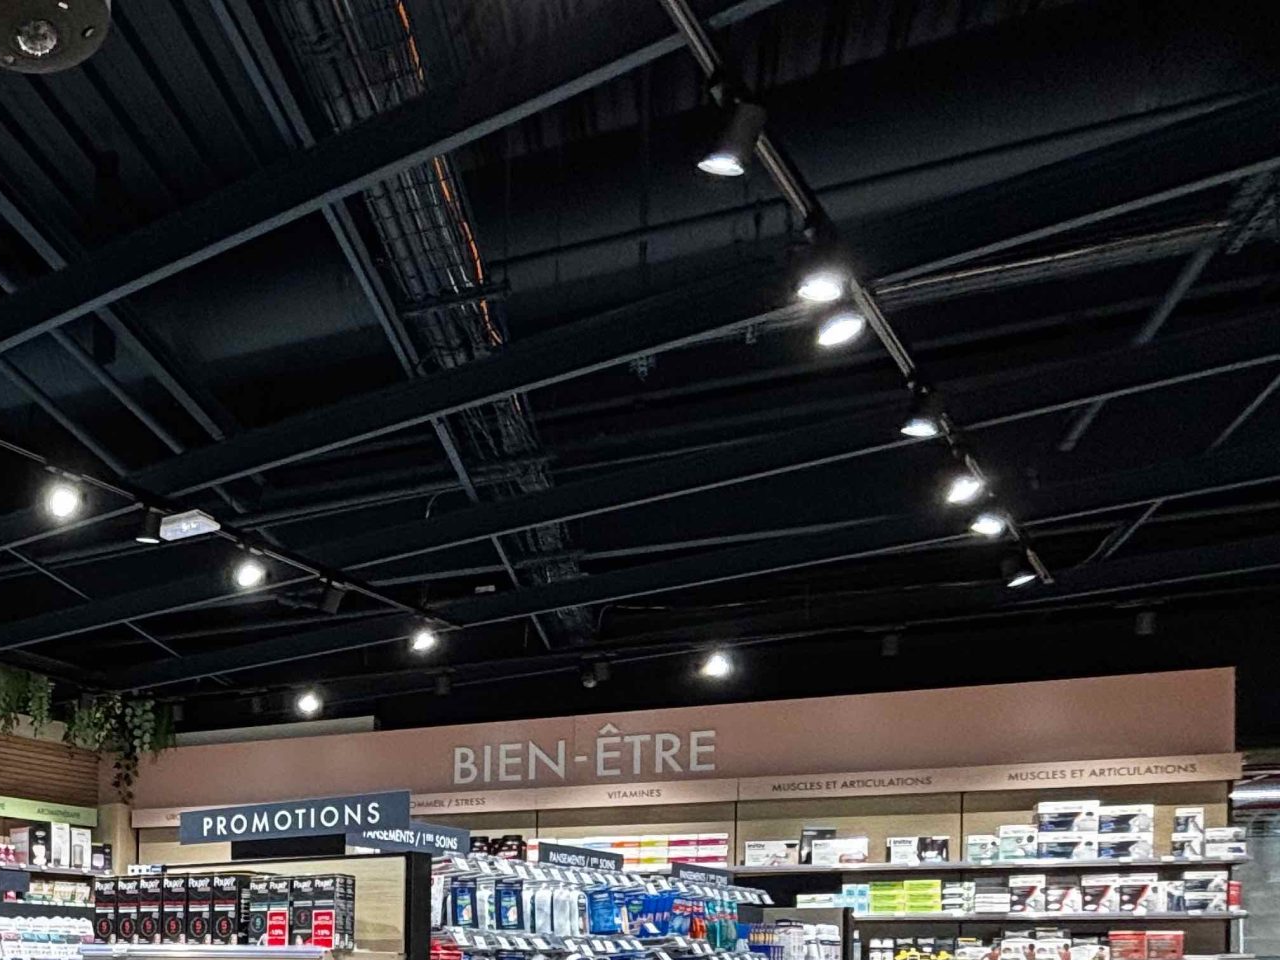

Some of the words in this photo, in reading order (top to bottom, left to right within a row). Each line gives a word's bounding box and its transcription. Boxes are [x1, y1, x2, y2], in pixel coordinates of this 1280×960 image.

[453, 723, 716, 785] BIEN-ÊTRE
[1008, 768, 1066, 782] MUSCLES
[1070, 768, 1084, 779] ET
[1088, 762, 1198, 779] ARTICULATIONS
[772, 781, 823, 793] MUSCLES
[826, 780, 839, 790] ET
[841, 775, 933, 790] ARTICULATIONS
[454, 797, 486, 807] STRESS
[607, 788, 662, 800] VITAMINES
[202, 801, 382, 838] PROMOTIONS
[435, 835, 458, 850] SOINS
[549, 851, 585, 867] PANSEMENTS
